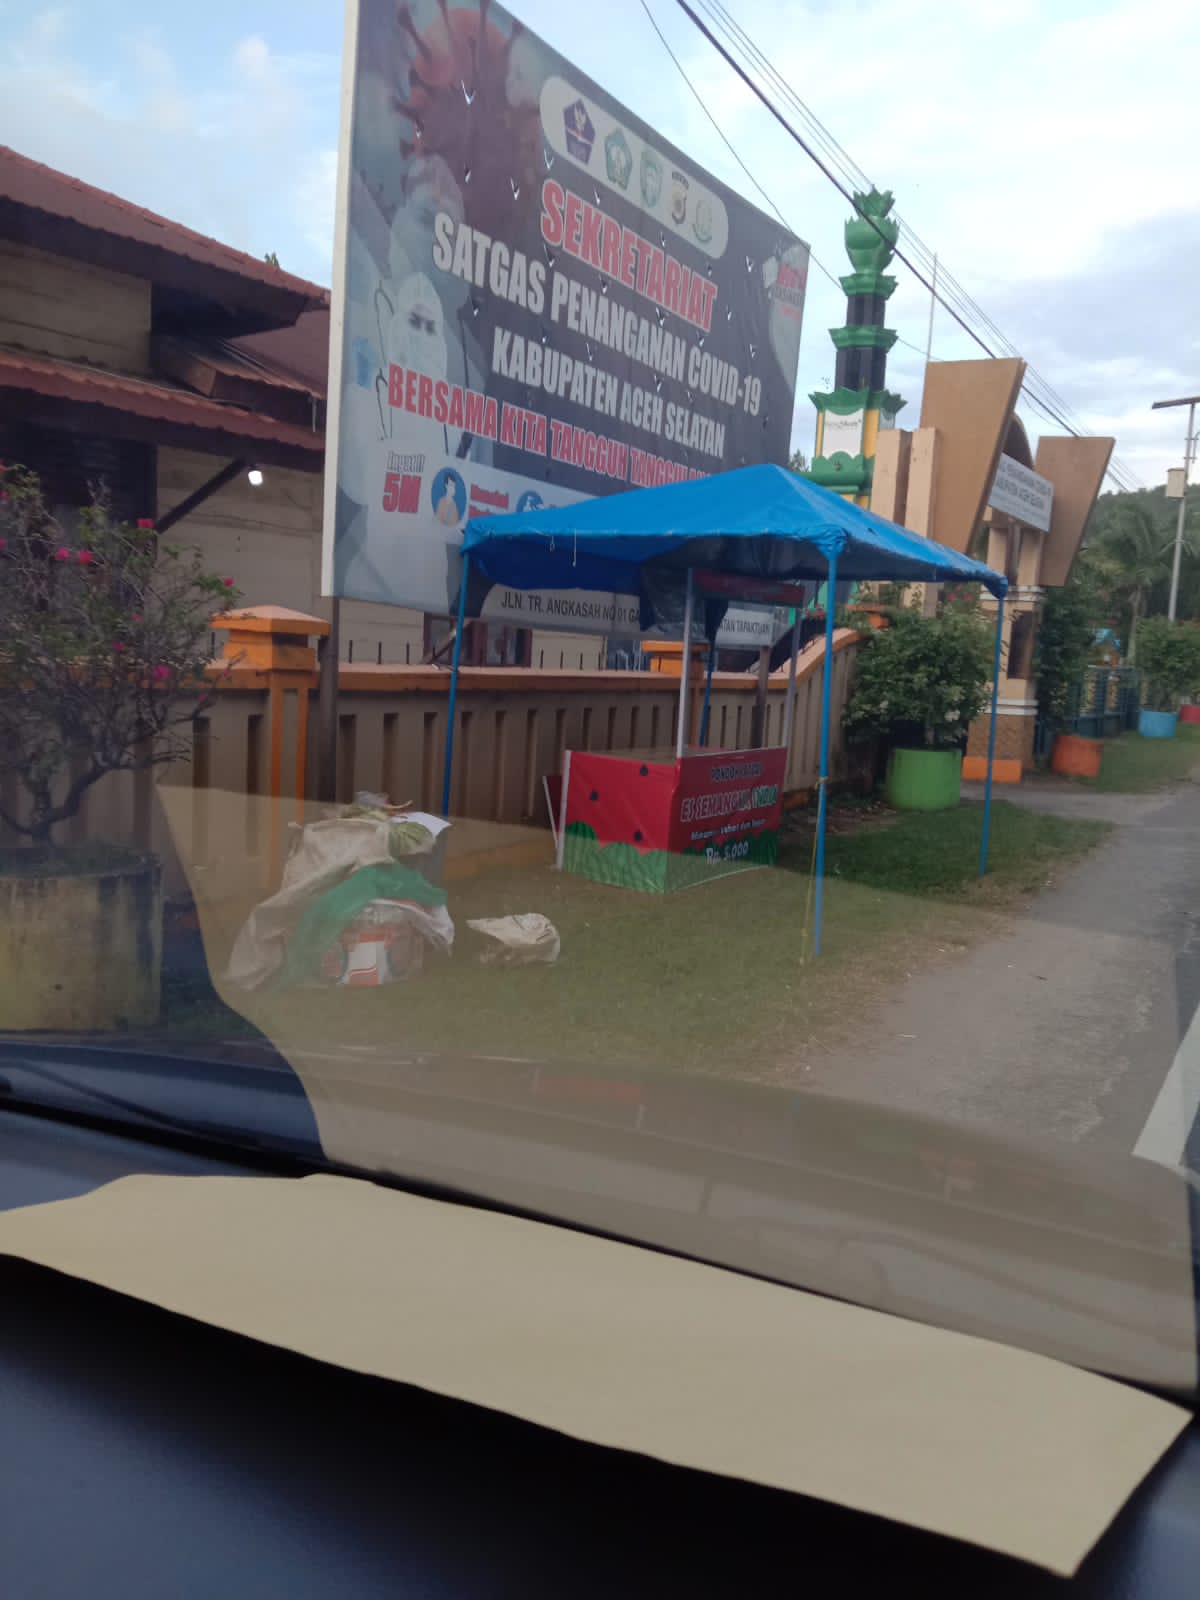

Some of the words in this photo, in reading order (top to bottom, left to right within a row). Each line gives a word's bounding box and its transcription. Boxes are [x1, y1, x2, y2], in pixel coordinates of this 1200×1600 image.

[432, 212, 546, 314] SATGAS
[550, 271, 687, 382] PENANGANAN
[687, 346, 762, 417] COVID-19
[540, 178, 718, 333] SEKRETARIAT
[387, 362, 498, 441] BERSAMA
[501, 402, 548, 457] KITA
[550, 417, 630, 481] TANGGUH
[492, 326, 619, 418] KABUPATEN
[619, 382, 664, 436] ACEH
[664, 402, 726, 459] SELATAN
[383, 472, 422, 513] 5M
